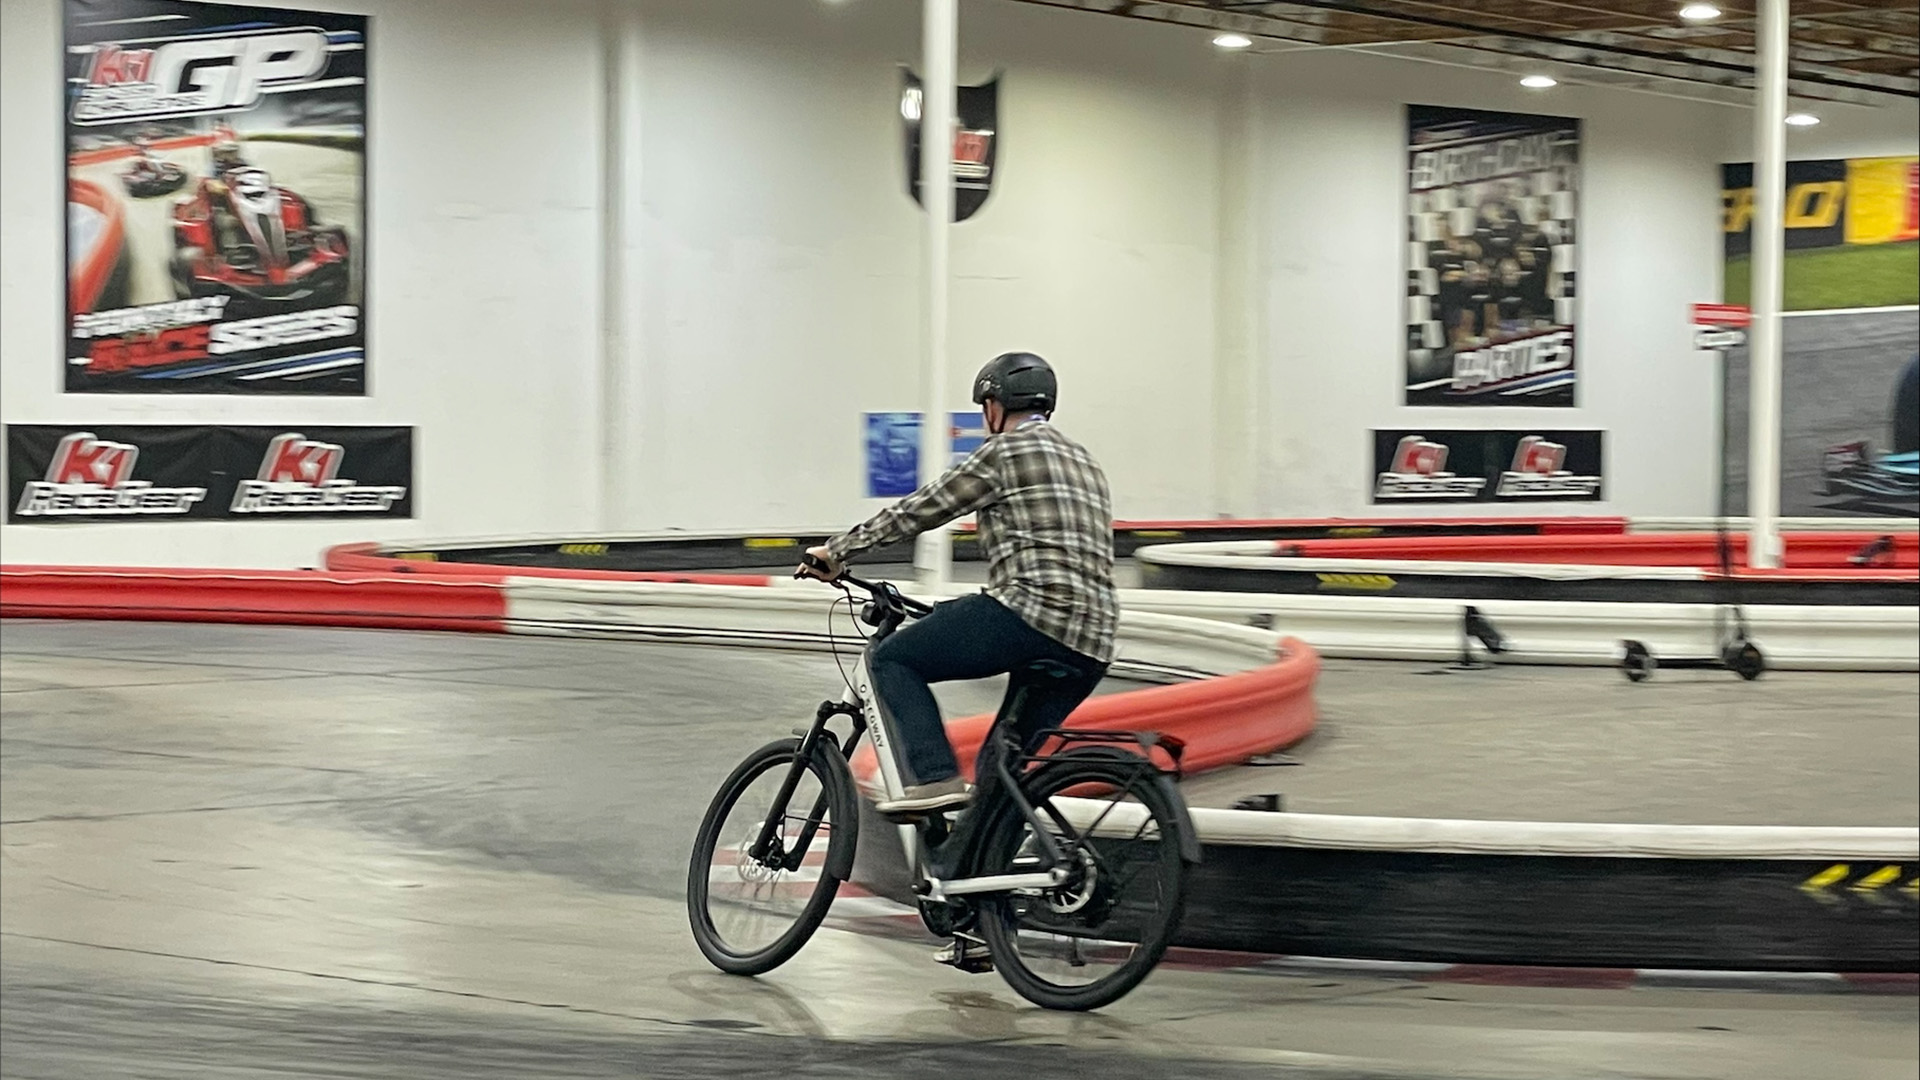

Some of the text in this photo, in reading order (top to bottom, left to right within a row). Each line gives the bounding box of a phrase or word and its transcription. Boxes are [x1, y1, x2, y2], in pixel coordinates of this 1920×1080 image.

[150, 32, 329, 107] GP
[207, 304, 360, 355] SERIES
[47, 433, 139, 489] K1
[257, 432, 345, 488] K1
[865, 698, 885, 748] SEGWAY
